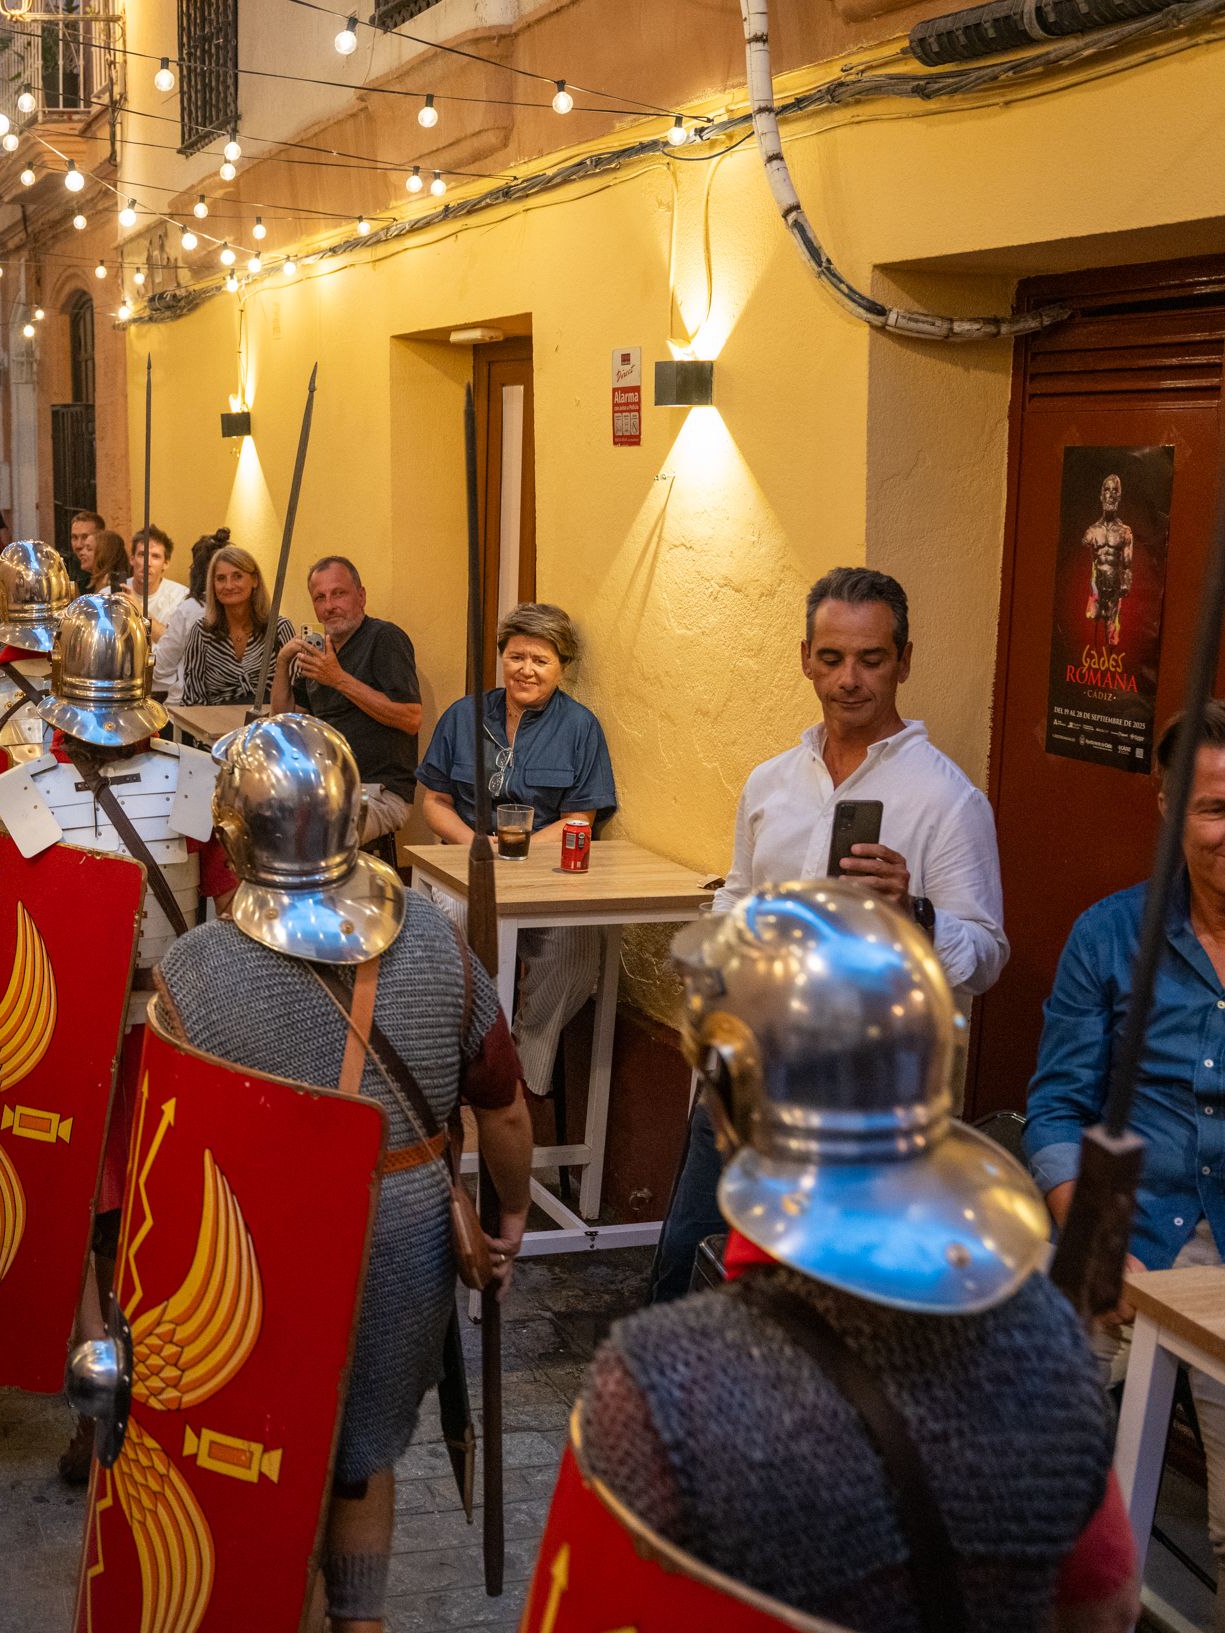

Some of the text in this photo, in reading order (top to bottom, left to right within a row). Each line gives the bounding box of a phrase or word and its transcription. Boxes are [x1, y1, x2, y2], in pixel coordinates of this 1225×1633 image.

[614, 390, 638, 402] Alarma
[1066, 665, 1138, 692] ROMANA
[1054, 706, 1064, 715] DEL
[1070, 709, 1076, 717] AL
[1076, 710, 1083, 718] 28
[1083, 712, 1090, 720] DE
[1091, 713, 1123, 726] SEPTIEMBRE
[1123, 719, 1132, 728] DE
[1133, 720, 1146, 729] 2025
